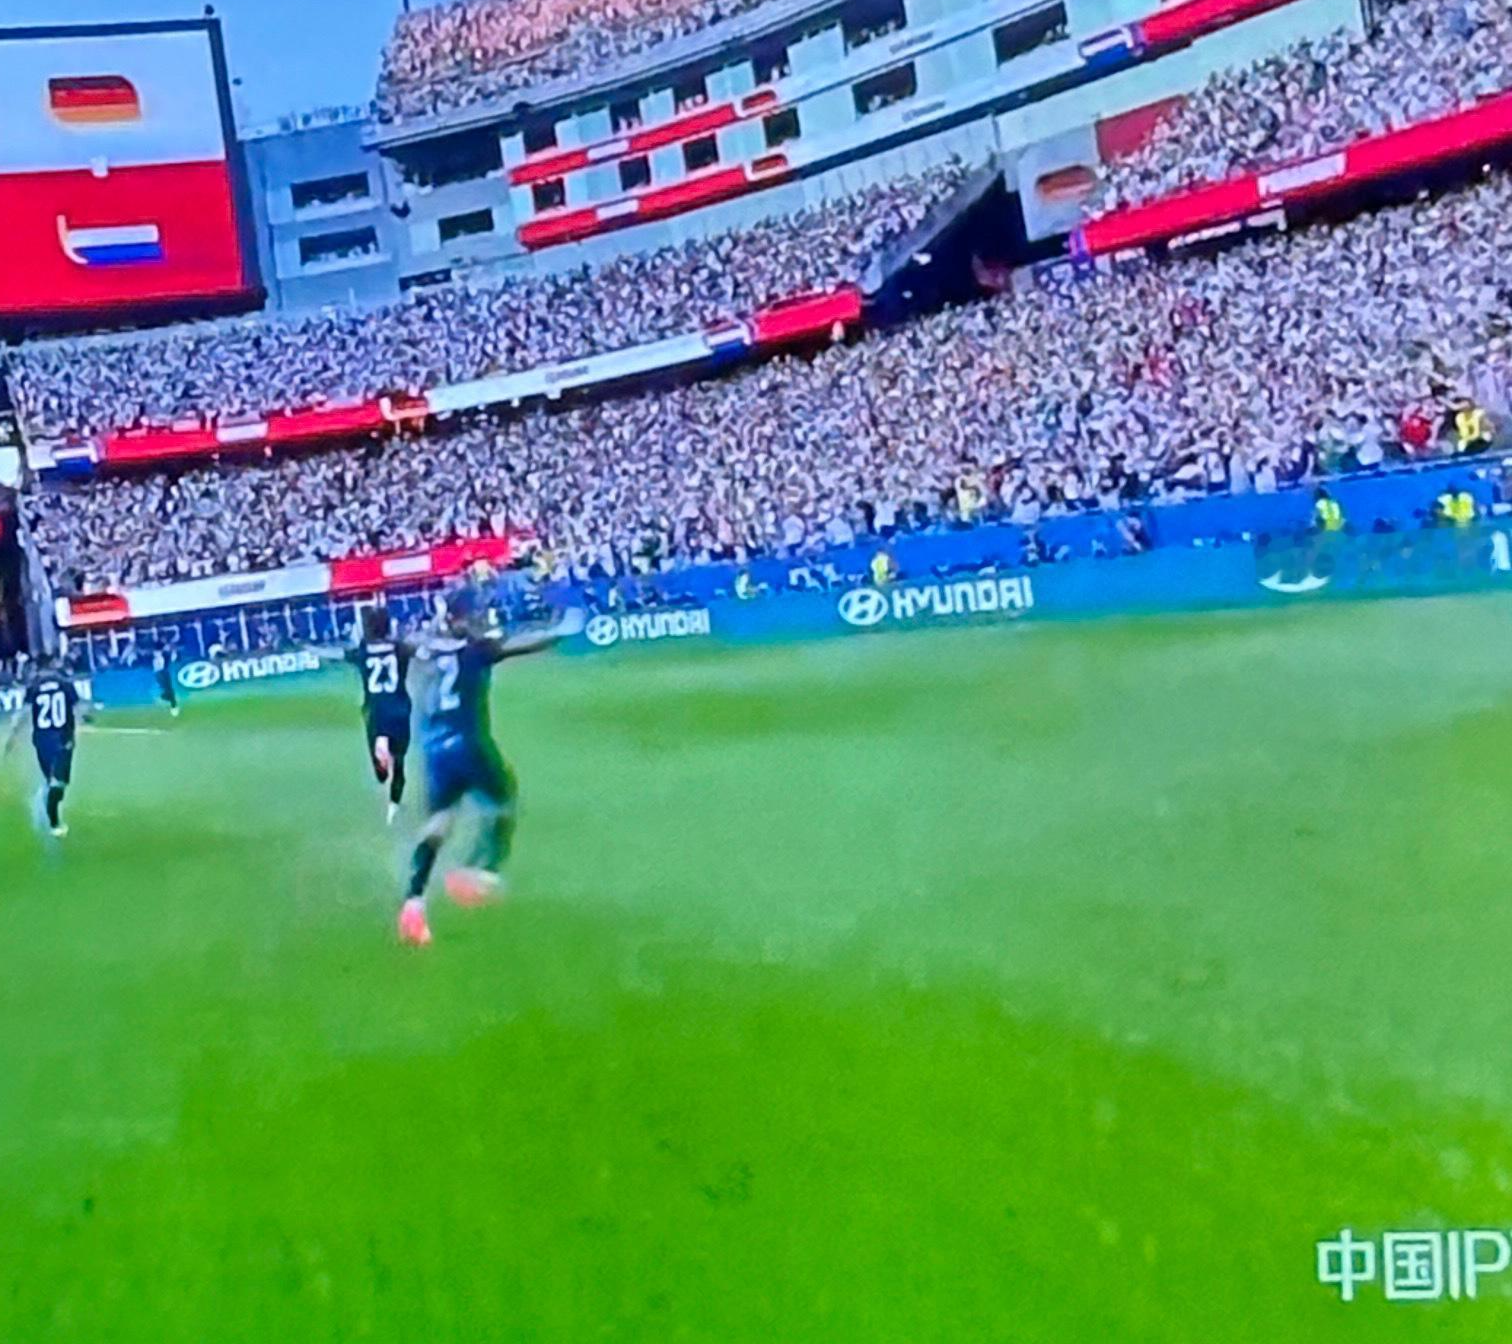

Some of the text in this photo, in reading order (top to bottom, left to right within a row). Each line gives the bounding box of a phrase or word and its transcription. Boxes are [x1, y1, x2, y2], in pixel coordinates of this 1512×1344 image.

[892, 575, 1034, 619] HYUNDAI
[620, 608, 711, 640] HYUNDAI
[221, 651, 320, 683] HYUNDAI
[366, 653, 398, 693] 23
[36, 690, 67, 729] 20
[1316, 1229, 1512, 1301] 中国IP
